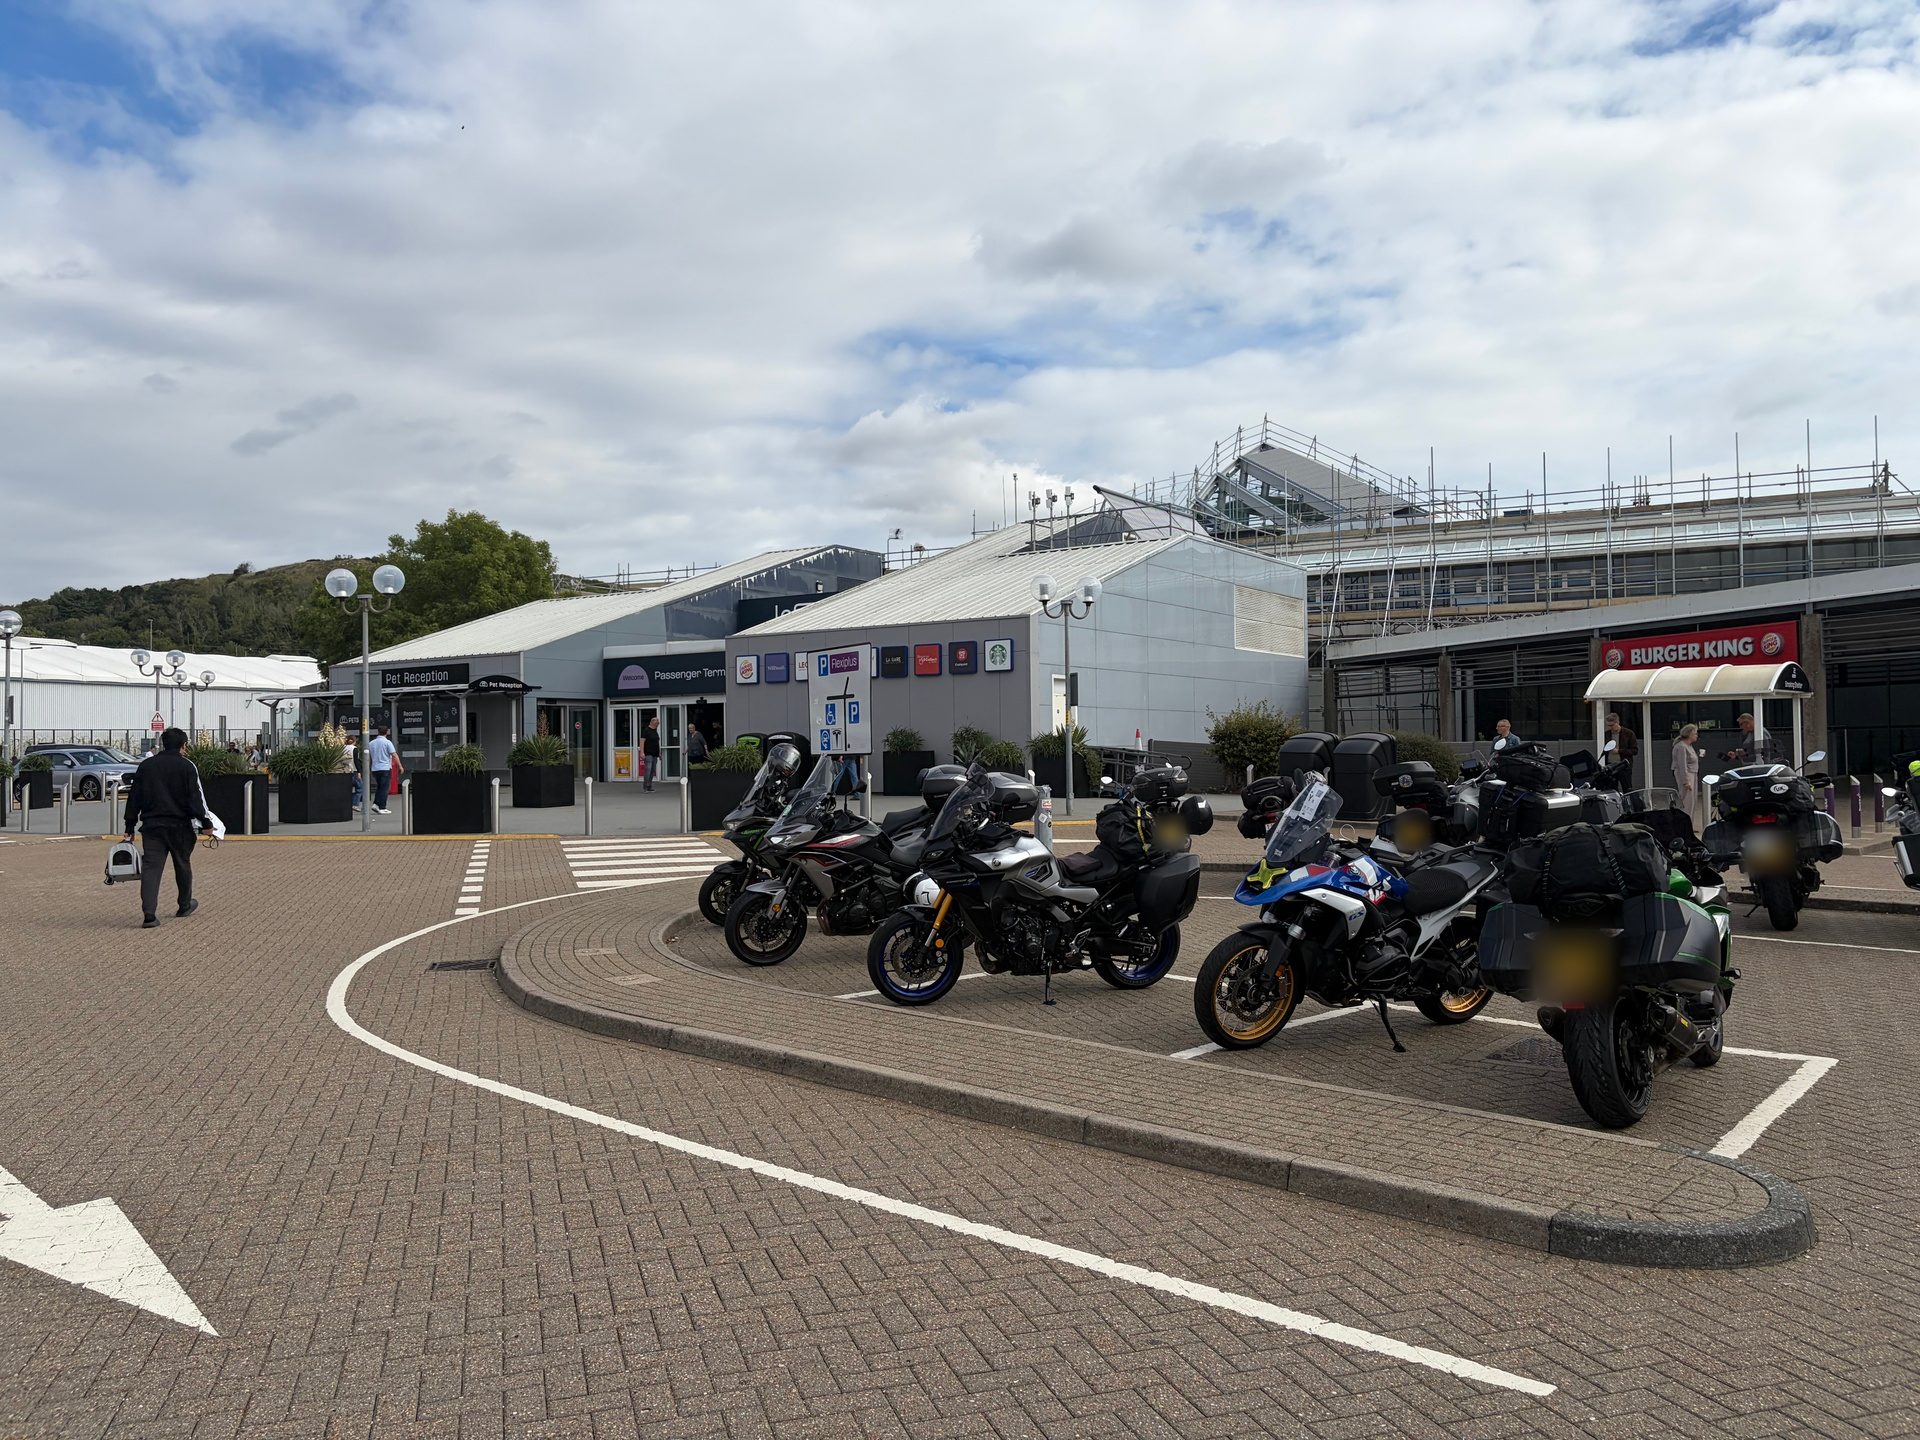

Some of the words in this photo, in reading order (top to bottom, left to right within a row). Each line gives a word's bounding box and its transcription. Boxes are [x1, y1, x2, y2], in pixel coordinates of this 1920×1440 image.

[1631, 642, 1701, 665] BURGER
[1704, 637, 1754, 659] KING
[654, 670, 702, 681] Passenger
[702, 667, 726, 678] Term
[820, 657, 828, 675] P
[831, 656, 858, 670] Flexiplus
[385, 673, 401, 685] Pet
[403, 670, 449, 685] Reception
[851, 703, 859, 722] P
